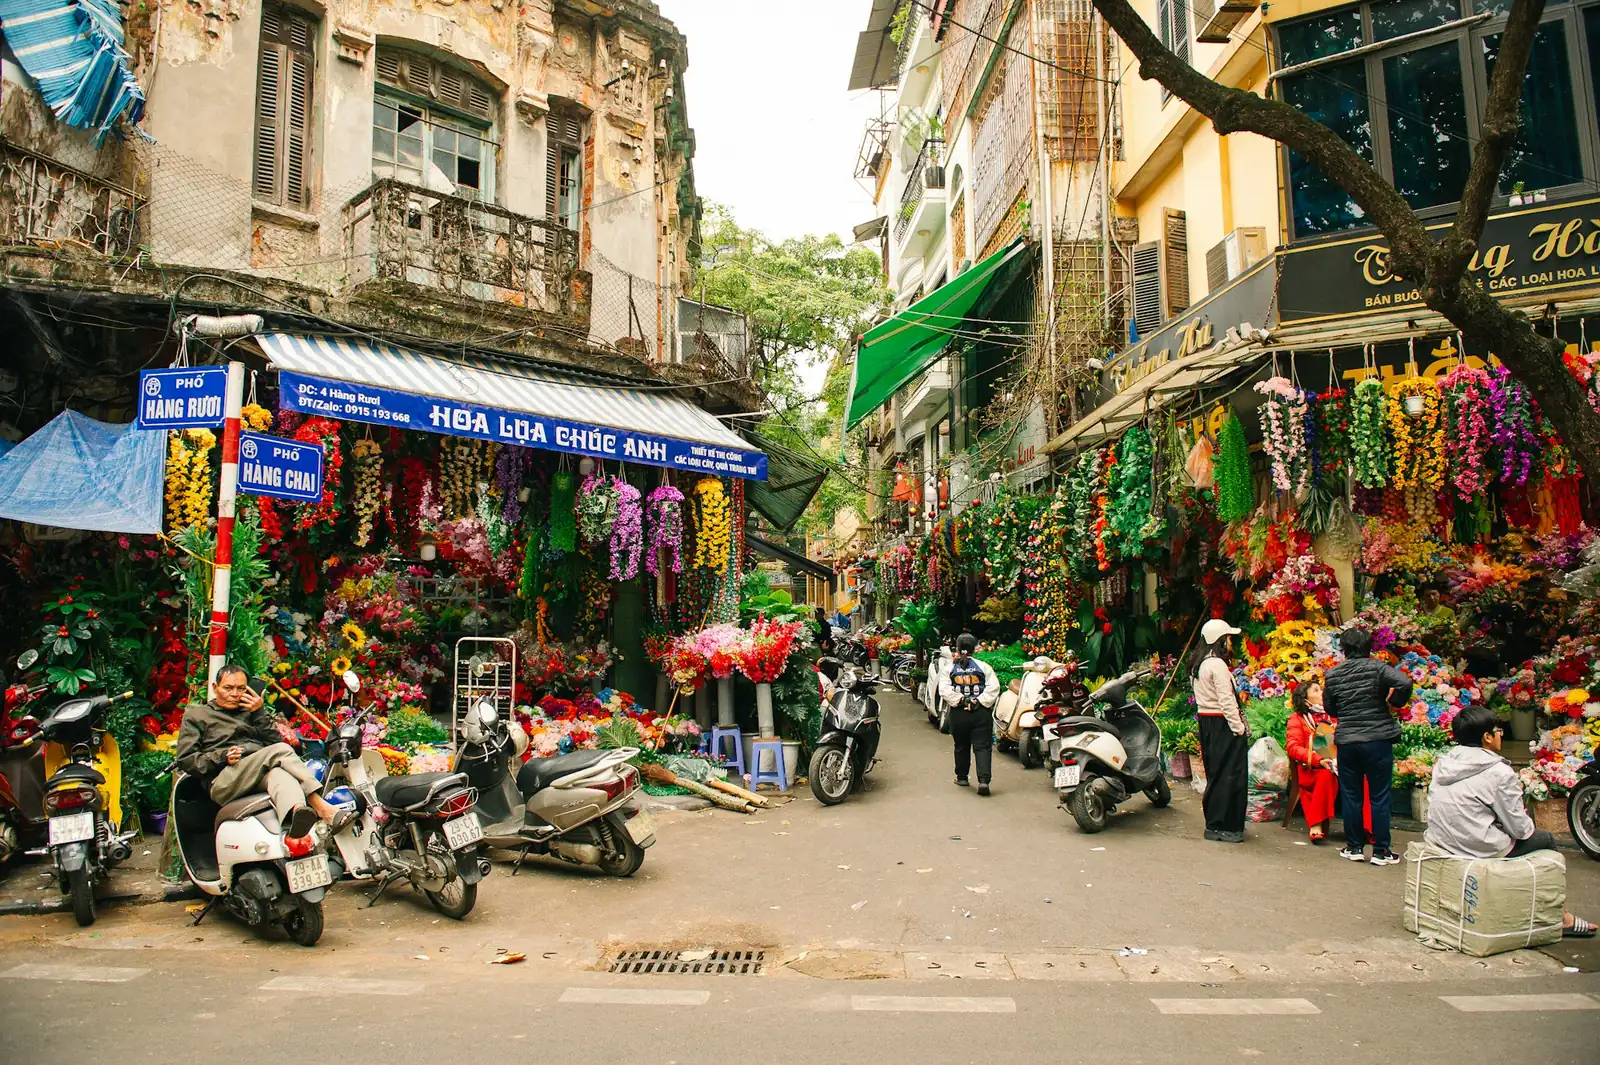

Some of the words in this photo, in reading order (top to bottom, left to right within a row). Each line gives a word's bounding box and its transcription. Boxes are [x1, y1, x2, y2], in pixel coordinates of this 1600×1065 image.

[1489, 275, 1517, 289] CÁC
[1521, 271, 1553, 285] LOẠI
[1557, 267, 1586, 280] HOA
[1365, 294, 1391, 307] BÁN
[1394, 288, 1422, 303] BUÔ
[175, 373, 205, 389] PHỐ
[298, 383, 318, 395] ĐC:
[320, 387, 328, 397] 4
[329, 388, 356, 404] Hàng
[358, 393, 381, 406] Rươi
[145, 394, 184, 419] HÀNG
[187, 395, 222, 418] RƯƠI
[298, 397, 342, 413] ĐT/Zalo:
[345, 404, 370, 417] 0915
[372, 408, 391, 420] 193
[392, 411, 411, 423] 668
[428, 404, 490, 435] HOA
[499, 416, 548, 444] LỤA
[555, 426, 617, 454] CHÚC
[623, 437, 668, 462] ANH
[273, 447, 302, 461] PHỐ
[690, 446, 707, 457] THIẾT
[707, 448, 716, 458] KẾ
[716, 451, 726, 459] THI
[726, 452, 742, 462] CÔNG
[674, 455, 687, 465] CÁC
[688, 457, 700, 468] LOẠI
[701, 459, 715, 469] CÂY,
[729, 463, 746, 474] TRANG
[747, 466, 757, 475] TRÍ
[243, 459, 282, 488] HÀNG
[285, 469, 316, 492] CHAI
[449, 816, 475, 834] 29-C1
[451, 826, 481, 848] 090.67
[292, 858, 323, 876] 29-AA
[292, 870, 328, 890] 339.33
